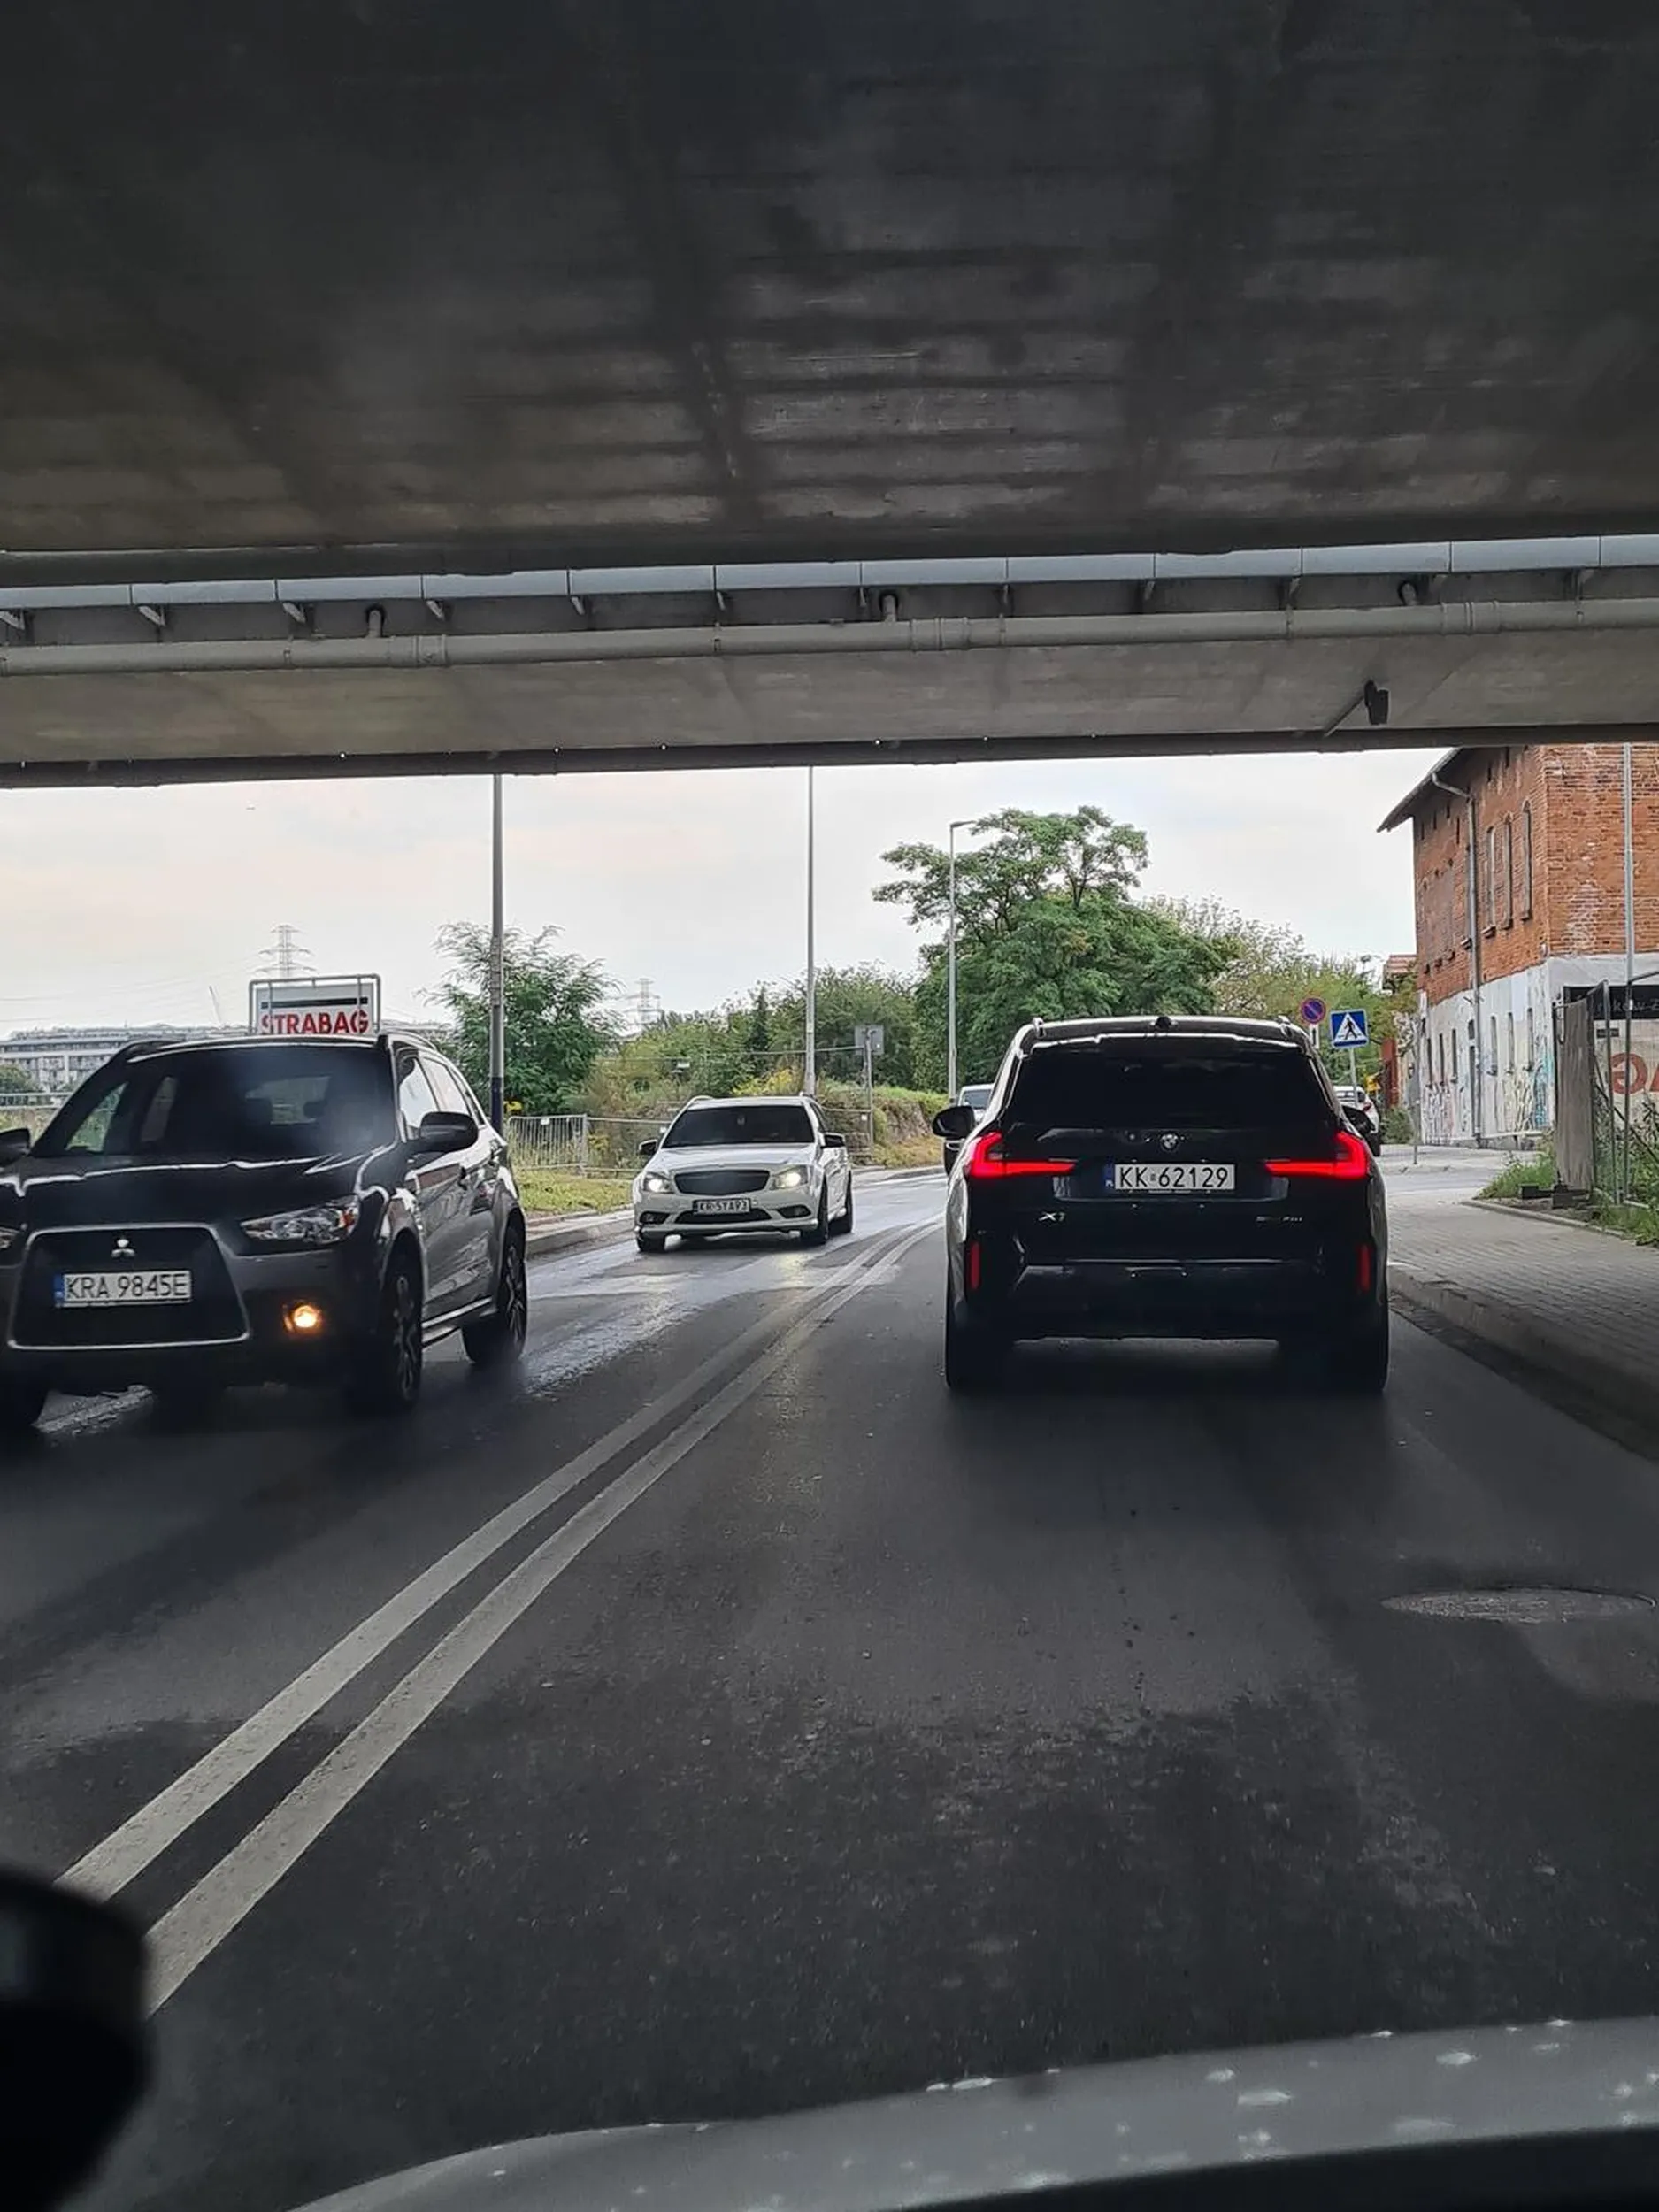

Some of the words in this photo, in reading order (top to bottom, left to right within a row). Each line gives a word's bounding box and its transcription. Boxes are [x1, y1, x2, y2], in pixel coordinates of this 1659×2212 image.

[261, 1009, 370, 1035] STRABAG
[1119, 1166, 1148, 1187] KK
[1158, 1166, 1228, 1187] 62129
[65, 1276, 111, 1299] KRA
[117, 1273, 188, 1297] 9845E
